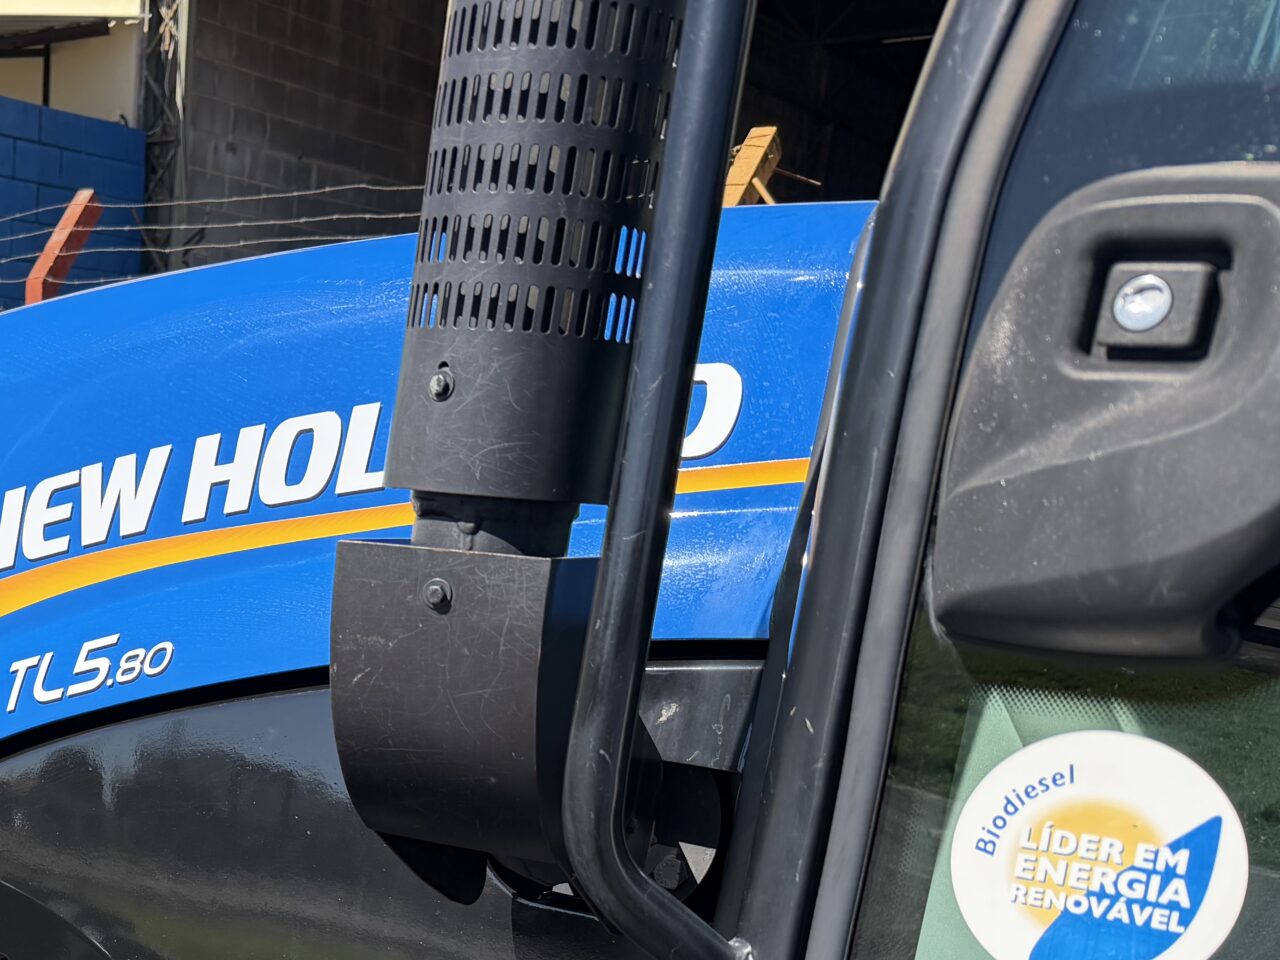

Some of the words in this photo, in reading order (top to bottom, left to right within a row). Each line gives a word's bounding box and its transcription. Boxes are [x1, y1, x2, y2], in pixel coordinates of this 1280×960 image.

[181, 362, 743, 525] HOLD
[974, 763, 1076, 857] Biodiesel
[1020, 820, 1125, 866] LÍDER
[1132, 841, 1191, 877] EM
[1010, 882, 1187, 934] RENOVÁVEL
[1014, 851, 1192, 909] ENERGIA
